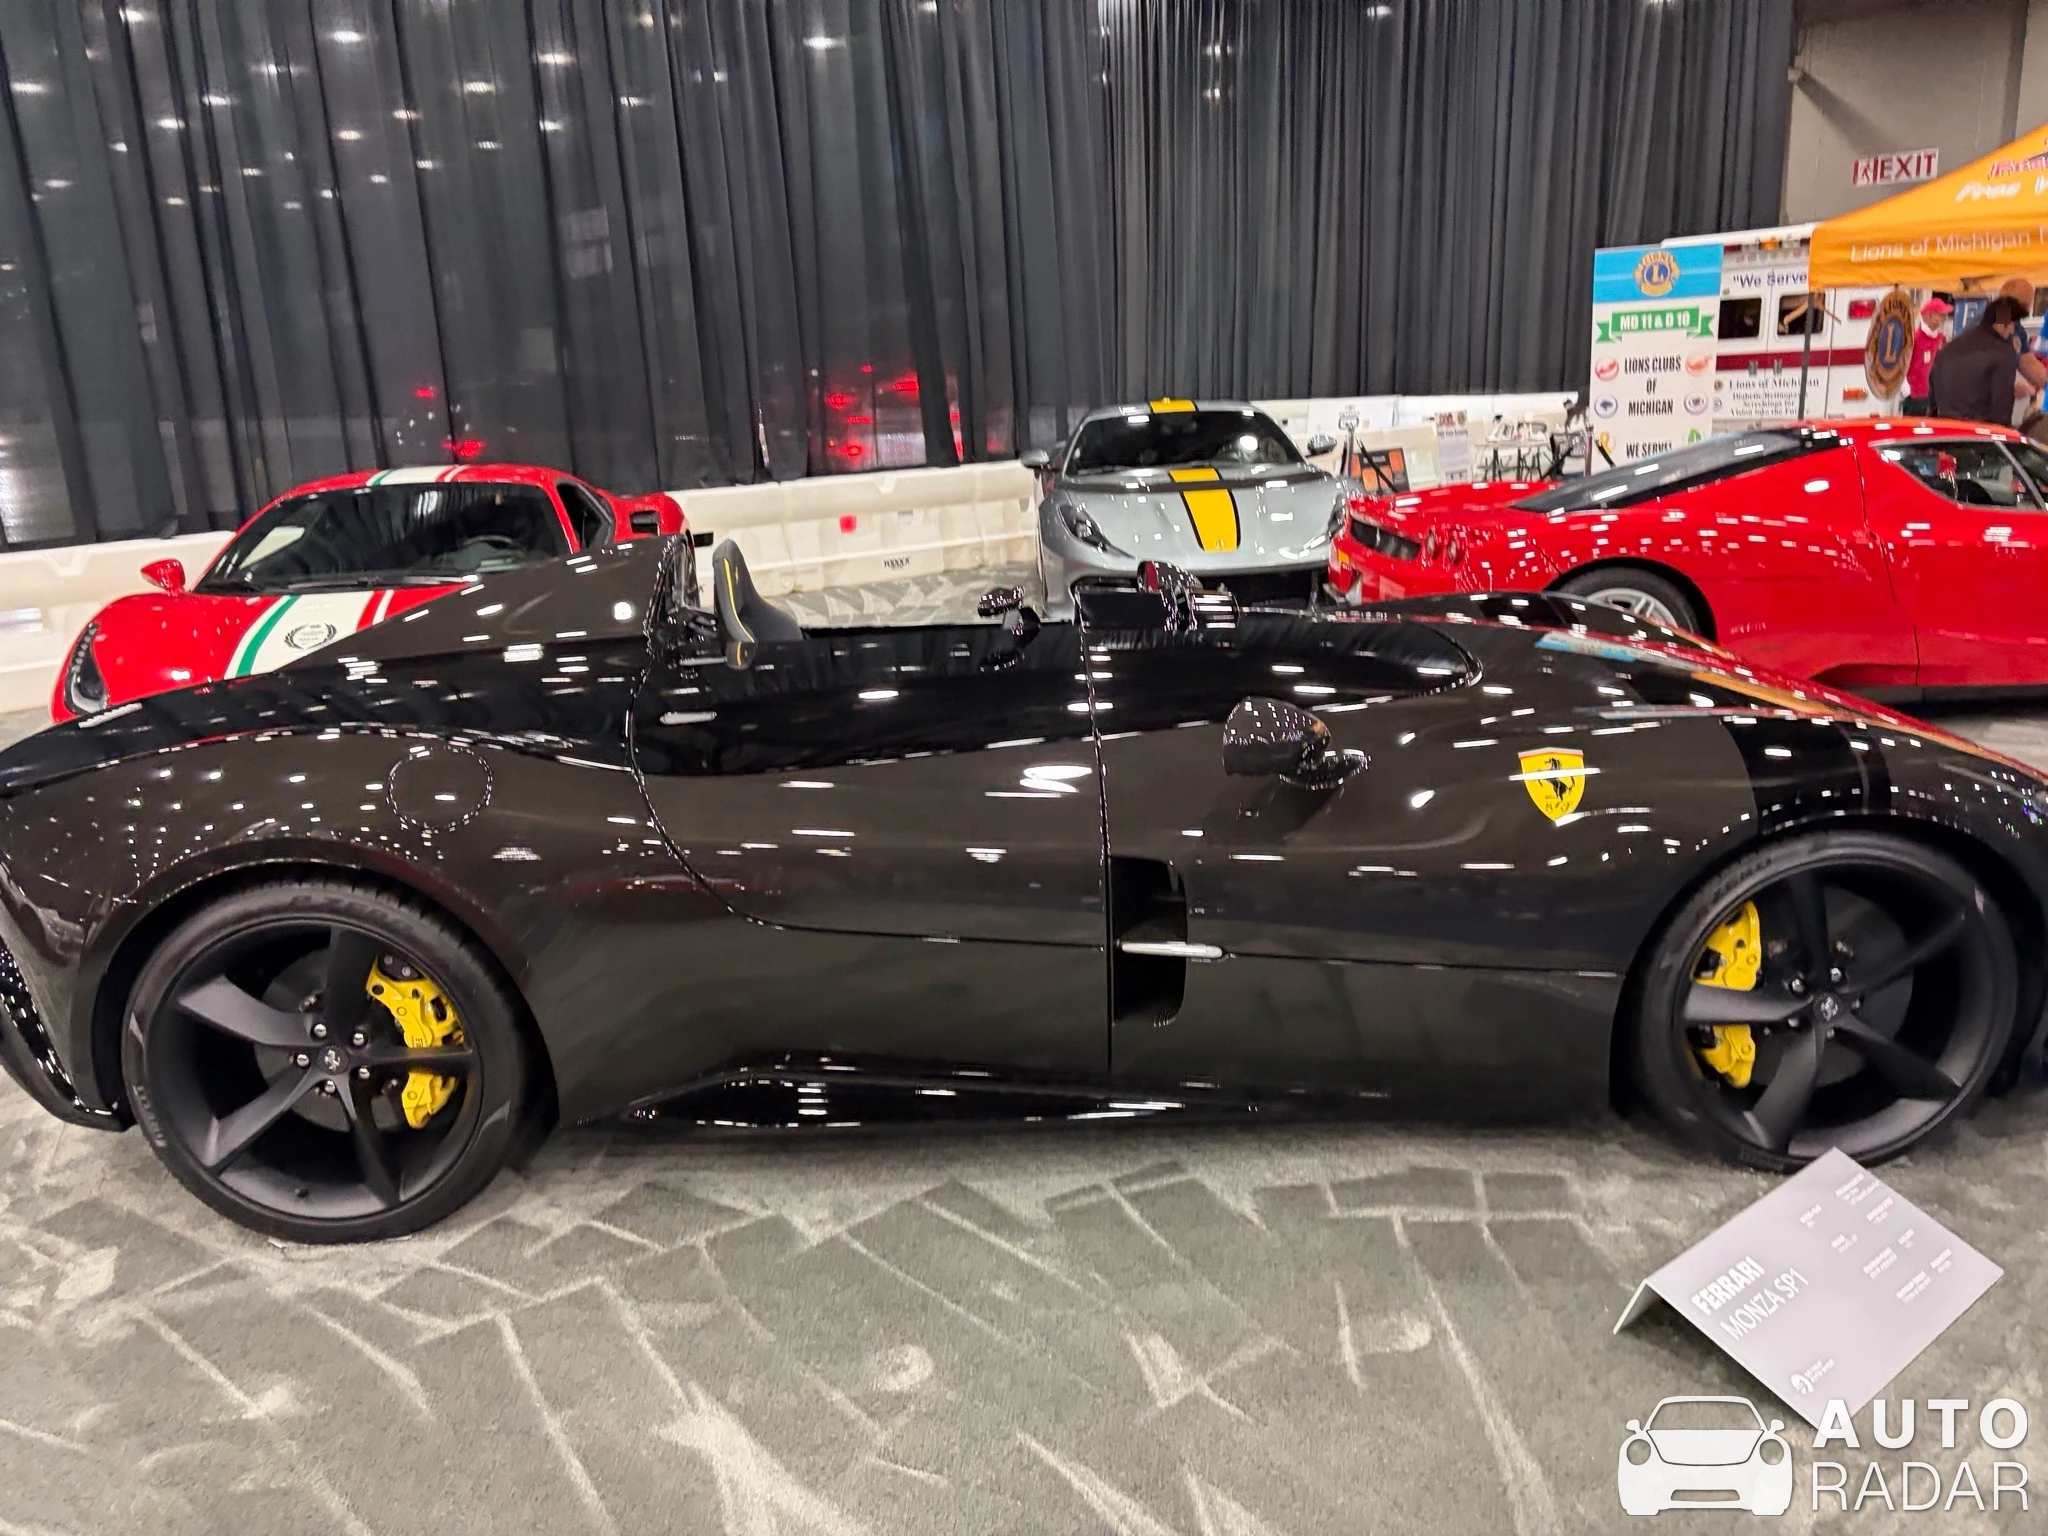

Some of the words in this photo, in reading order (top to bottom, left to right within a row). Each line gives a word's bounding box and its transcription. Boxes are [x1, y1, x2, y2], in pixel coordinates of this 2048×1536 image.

[1880, 153, 1936, 180] EXIT
[1850, 242, 1904, 262] Lions
[1910, 236, 1929, 257] of
[1936, 229, 2031, 254] Michigan
[1620, 314, 1639, 331] MD
[1642, 312, 1653, 330] 11
[1677, 310, 1690, 328] 10
[1624, 356, 1650, 374] LIONS
[1651, 355, 1681, 373] CLUBS
[1646, 377, 1657, 395] OF
[1773, 377, 1819, 388] Michian
[1628, 399, 1674, 417] MICHIGAN
[1625, 442, 1639, 459] WE
[1690, 1255, 1766, 1317] FERRARI
[1719, 1287, 1787, 1341] MONZA
[1773, 1266, 1809, 1299] SP1
